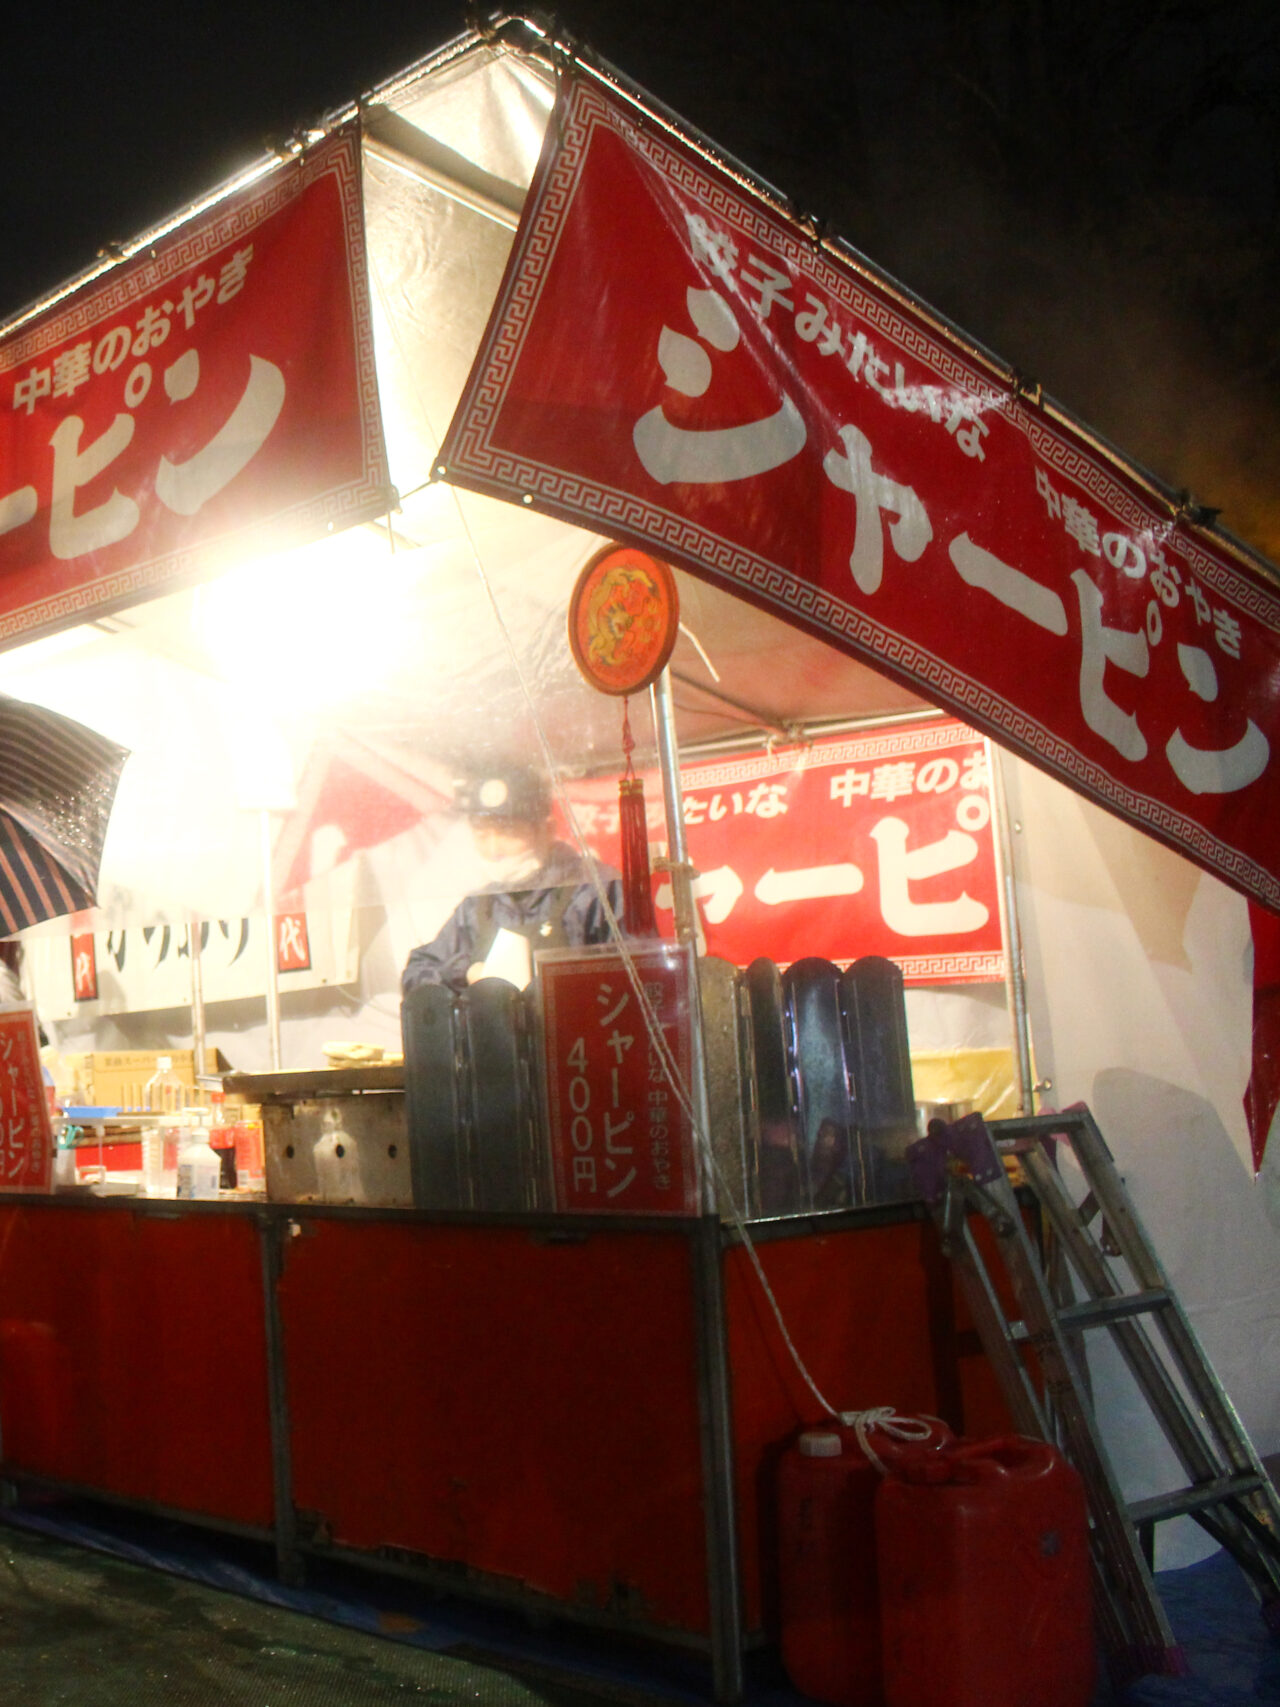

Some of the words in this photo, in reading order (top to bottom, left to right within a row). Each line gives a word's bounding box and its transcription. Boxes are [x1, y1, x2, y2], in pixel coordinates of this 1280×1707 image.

[12, 243, 254, 416] 中華のおやき
[685, 213, 990, 463] 餃子みたいな
[1034, 464, 1243, 660] 中華のおやき
[633, 284, 1271, 796] シャーピン
[650, 795, 990, 957] ャーピ
[0, 1031, 25, 1178] シャーピン
[567, 1037, 597, 1194] 400円
[597, 983, 637, 1198] シャーピン
